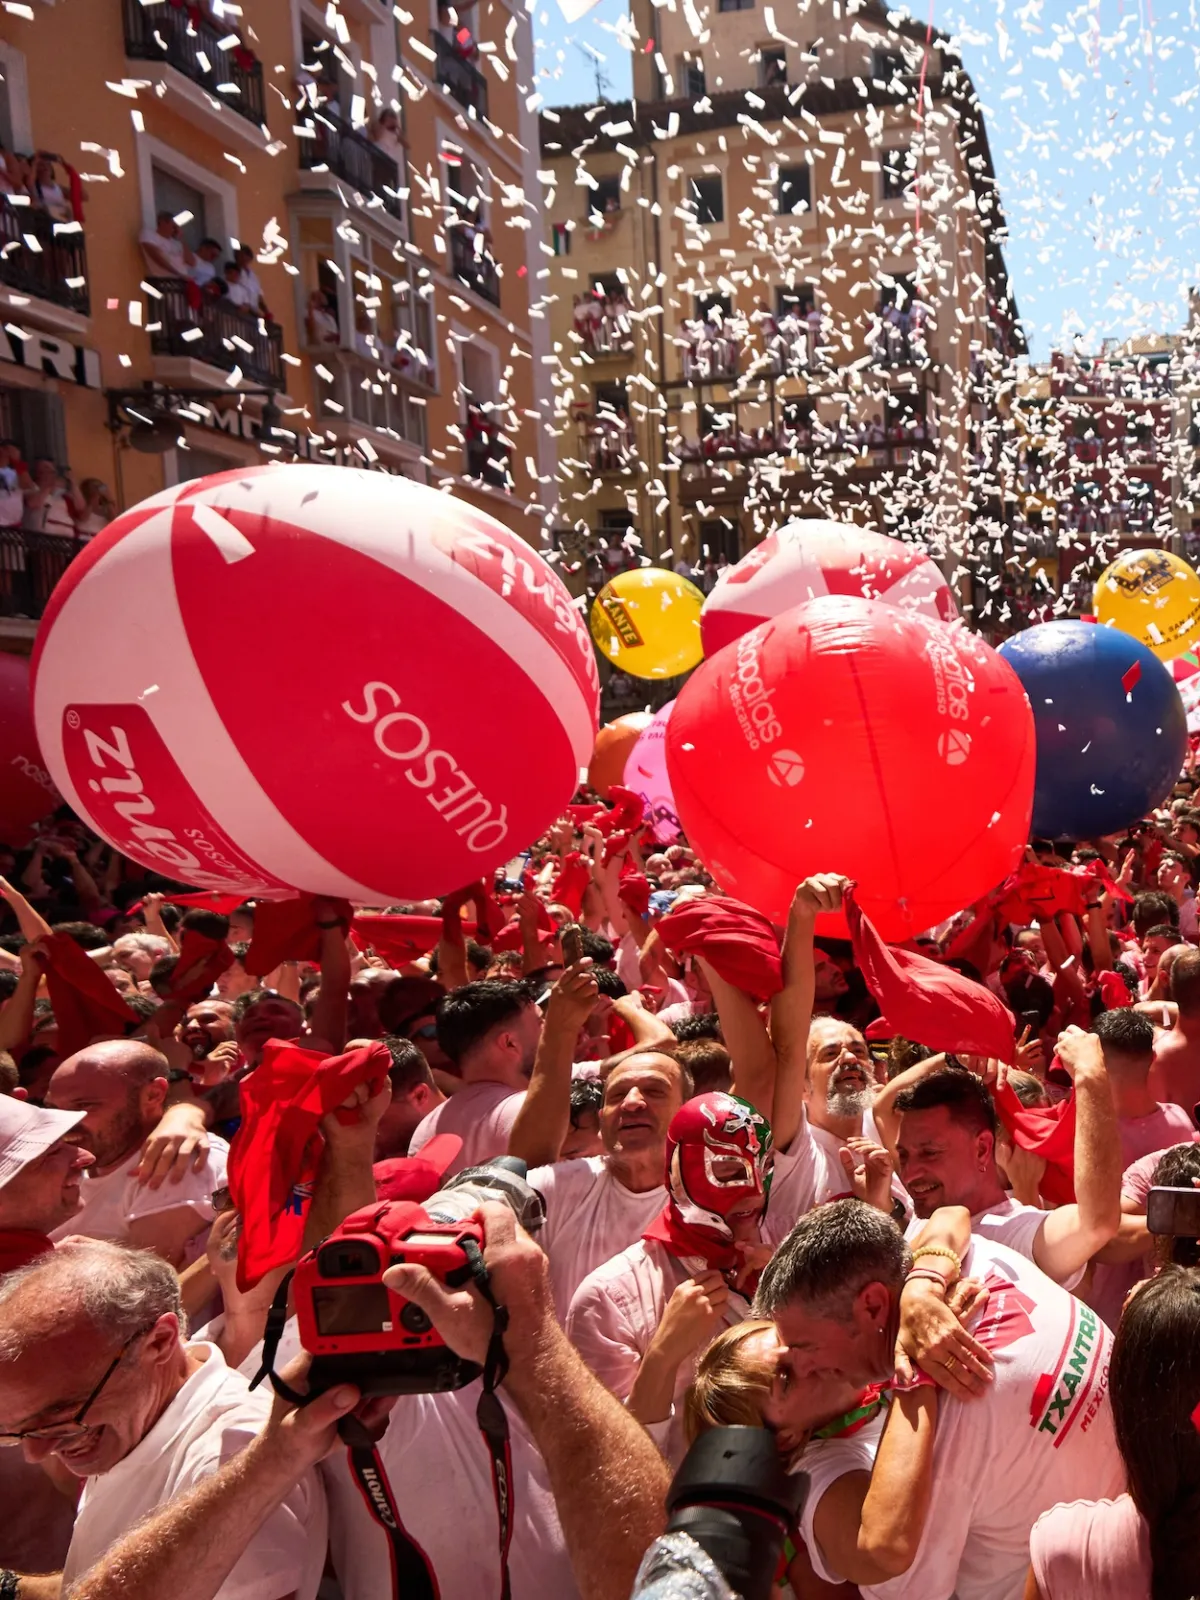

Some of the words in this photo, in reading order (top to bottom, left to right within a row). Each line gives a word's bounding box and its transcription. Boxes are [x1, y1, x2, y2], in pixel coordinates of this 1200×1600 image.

[728, 682, 760, 751] descanso
[340, 680, 509, 853] QUESOS
[362, 1467, 398, 1530] Canon
